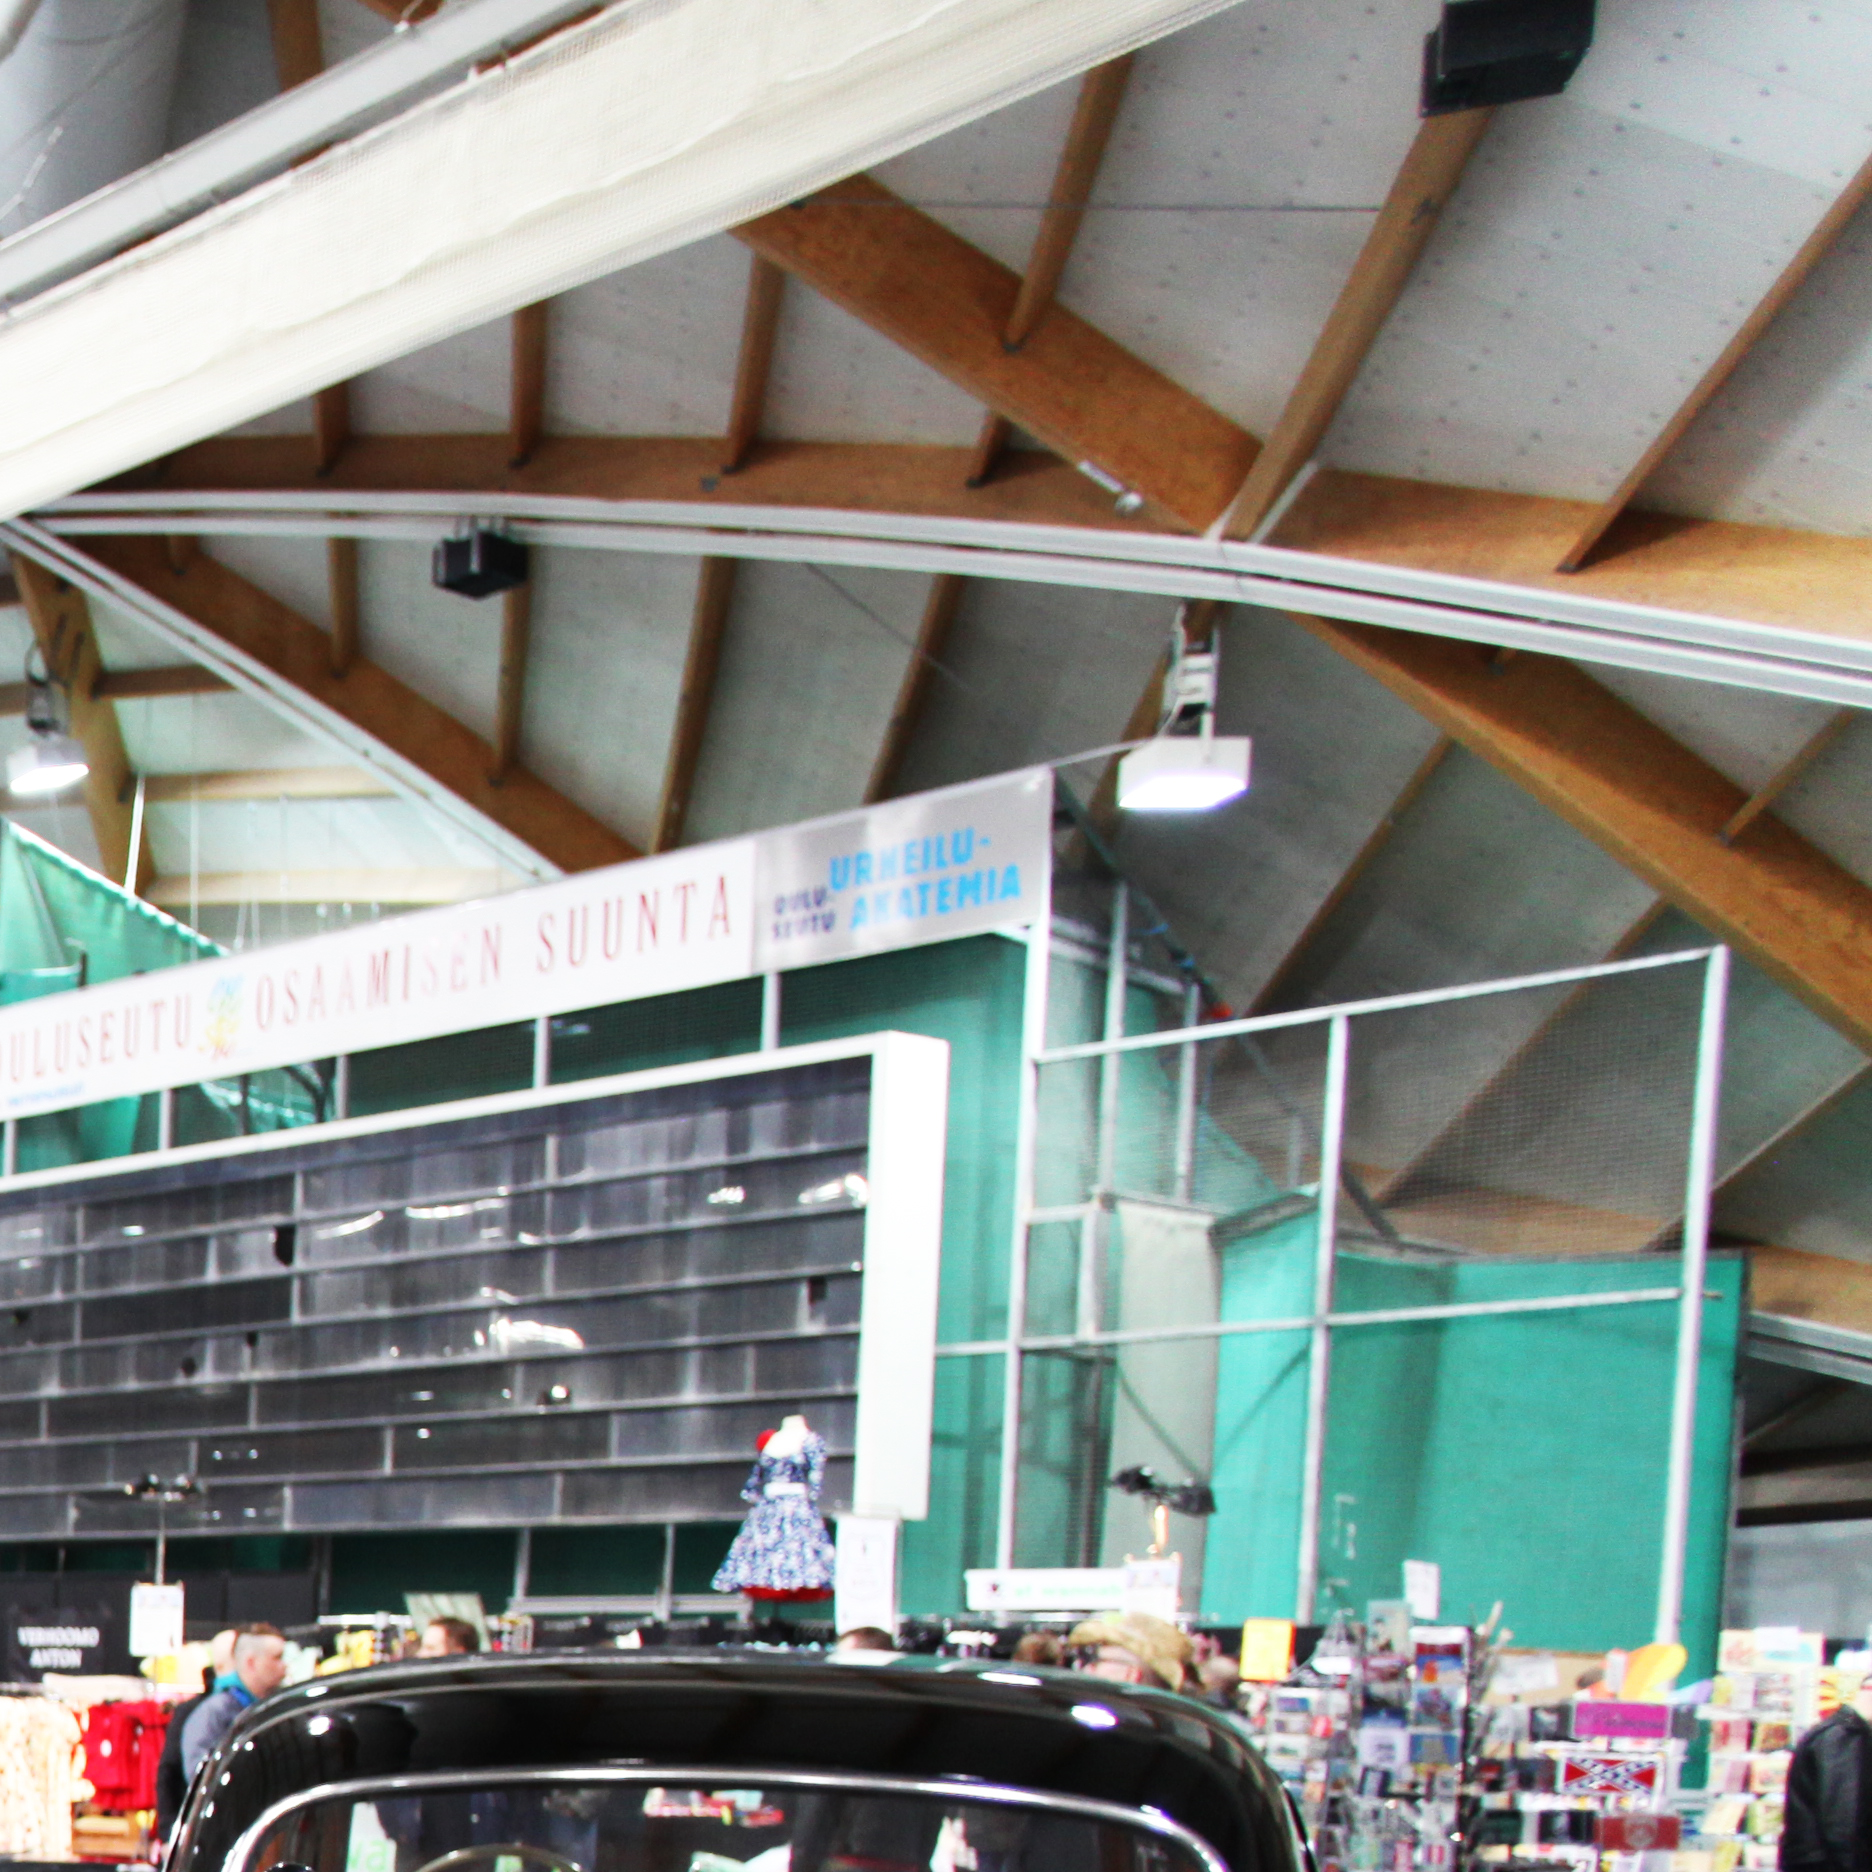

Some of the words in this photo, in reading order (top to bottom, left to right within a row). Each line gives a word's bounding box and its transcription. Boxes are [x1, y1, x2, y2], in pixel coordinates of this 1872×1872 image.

[829, 827, 991, 891] URHEILU-
[849, 863, 1021, 930] AKATEMIA
[256, 922, 502, 1032] OSAAMISEN
[537, 874, 731, 974] SUUNTA
